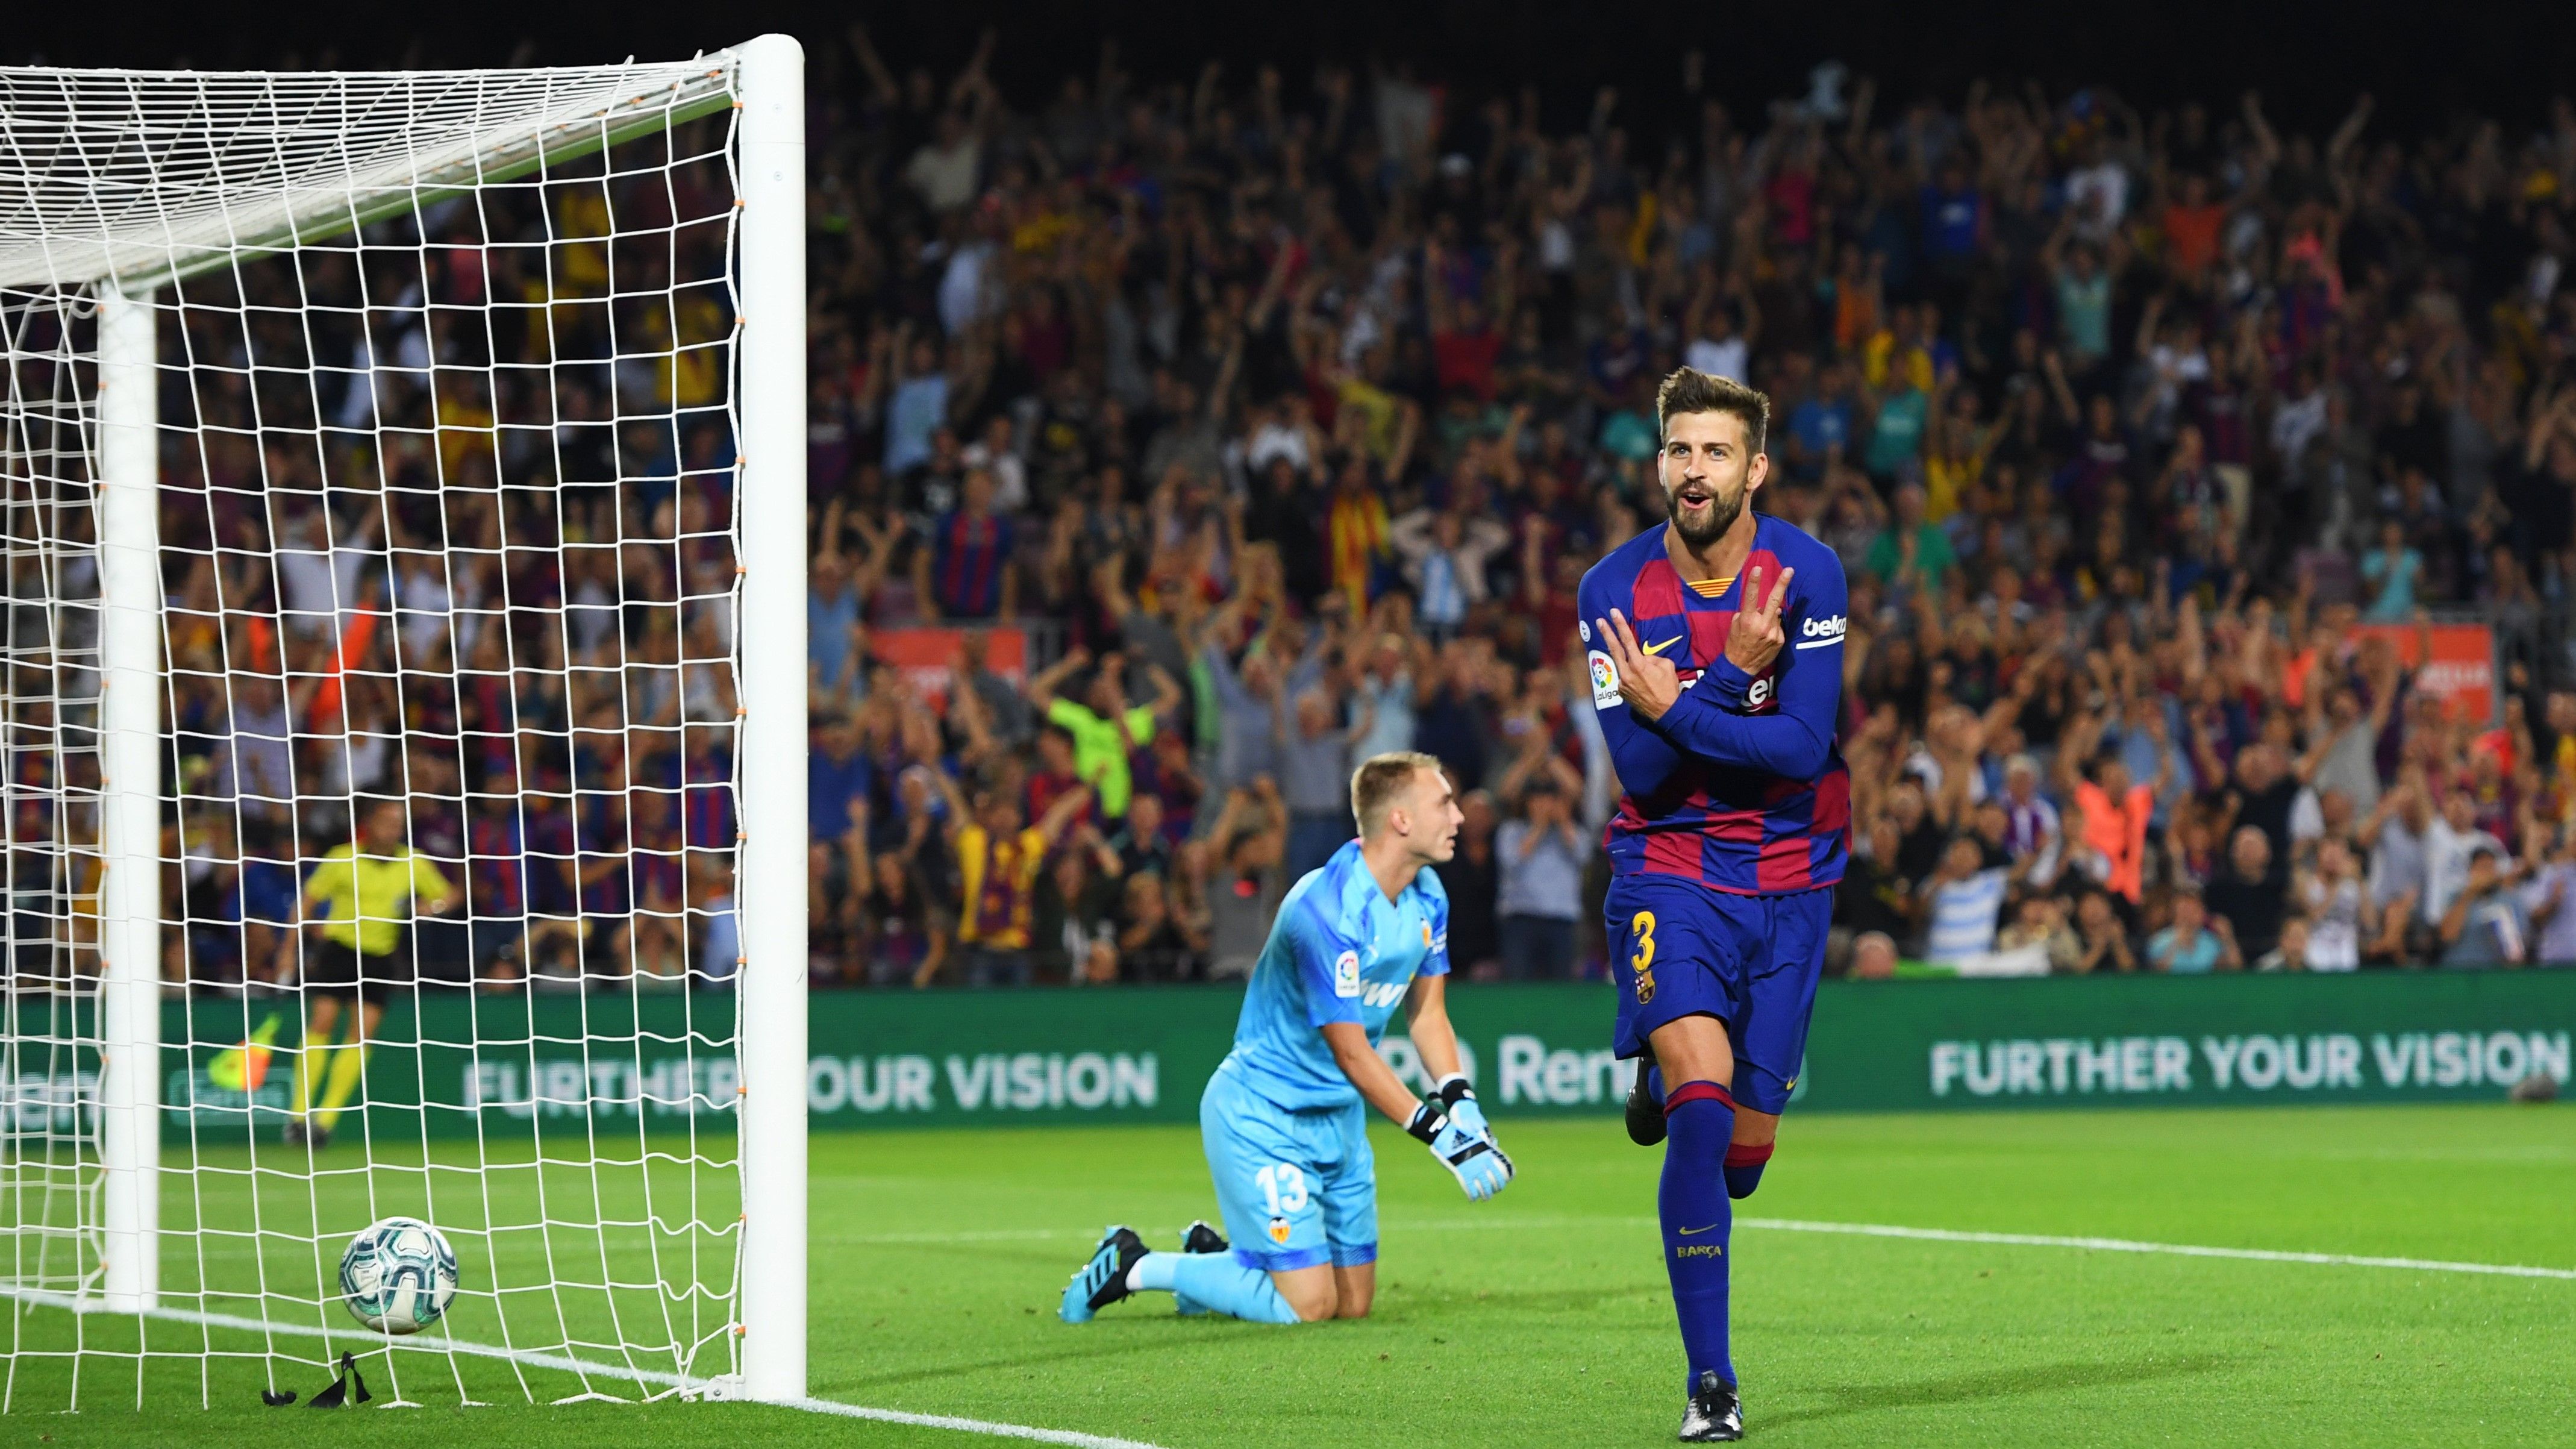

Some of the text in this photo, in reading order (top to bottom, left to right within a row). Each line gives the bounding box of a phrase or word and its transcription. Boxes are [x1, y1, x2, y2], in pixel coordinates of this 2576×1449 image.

[1803, 615, 1846, 636] beko
[1631, 911, 1655, 974] 3
[463, 1052, 1158, 1118] FURTHER OUR VISION
[1498, 1033, 1637, 1105] Ren
[1931, 1030, 2569, 1096] FURTHER YOUR VISION
[1255, 1162, 1308, 1216] 13
[1677, 1245, 1722, 1258] BARÇA
